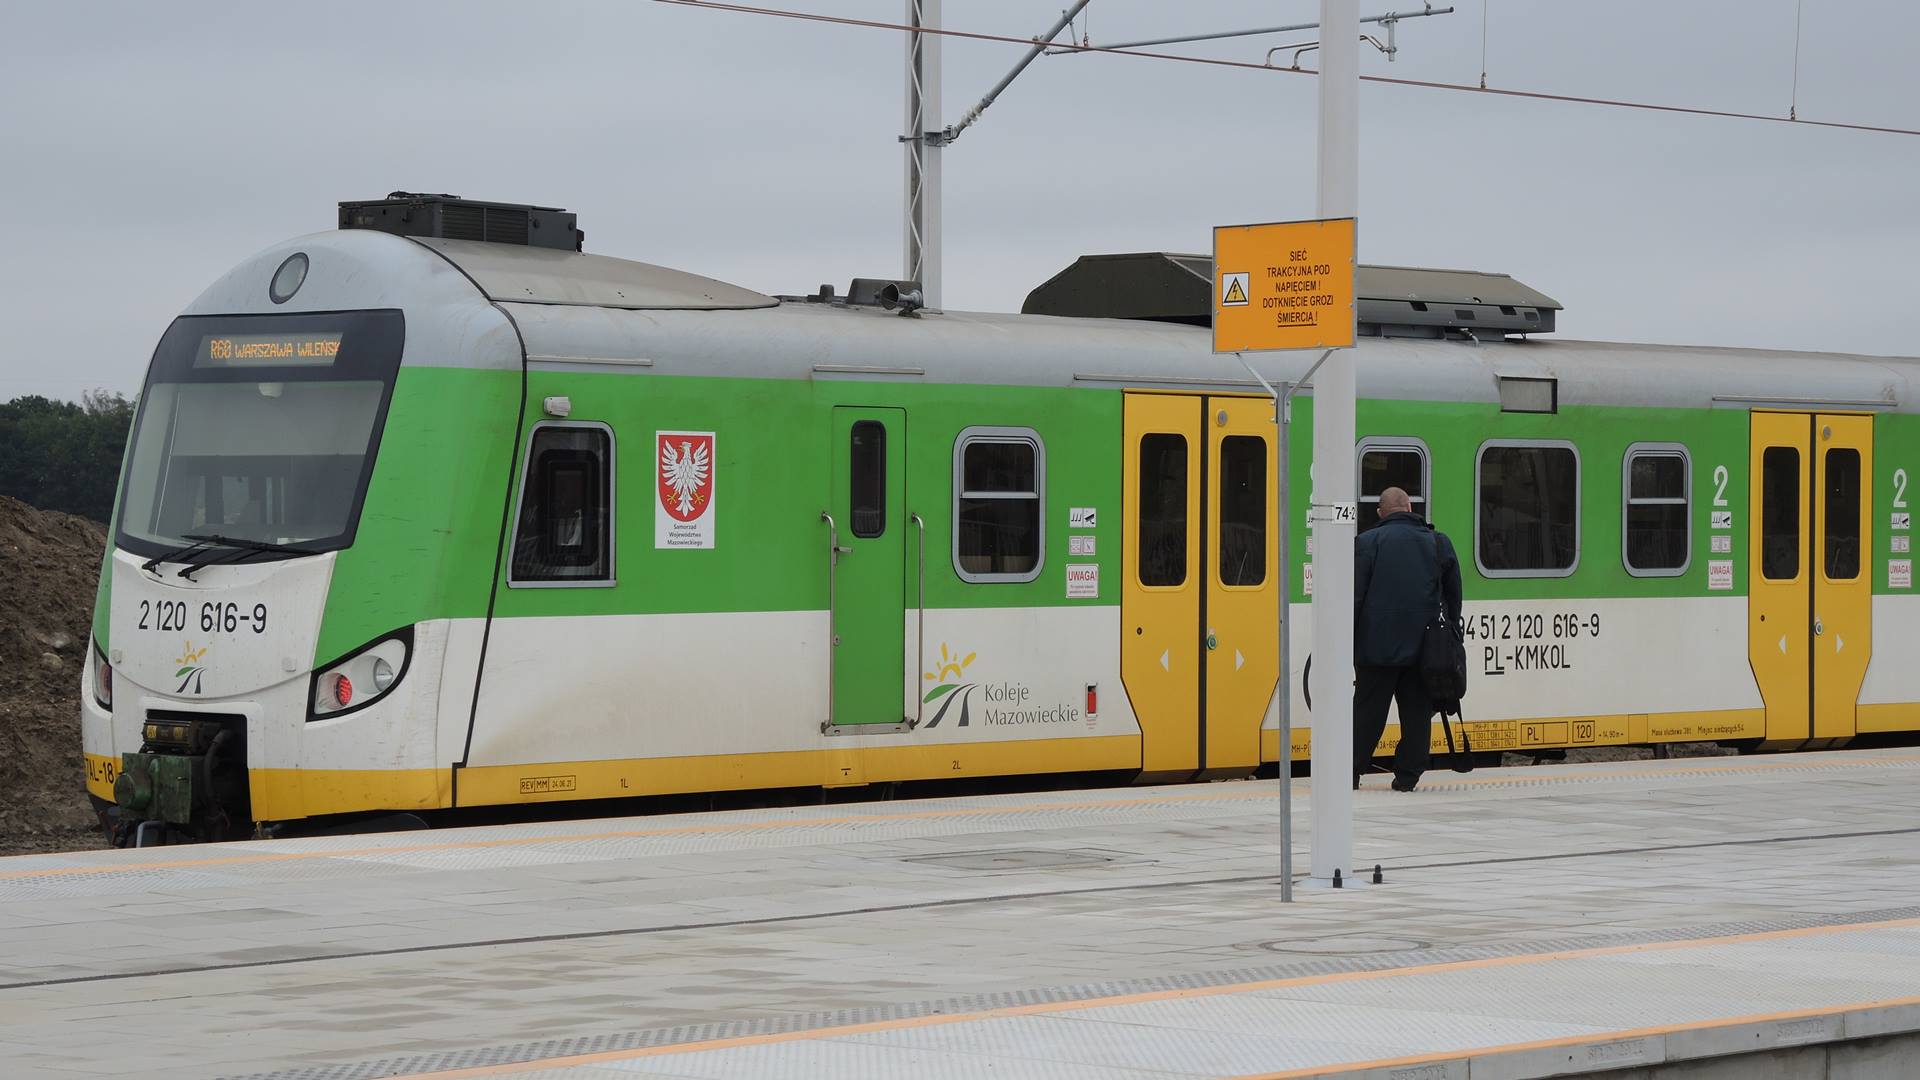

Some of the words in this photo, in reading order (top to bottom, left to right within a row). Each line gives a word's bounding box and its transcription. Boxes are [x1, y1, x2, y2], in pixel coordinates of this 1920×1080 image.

[1290, 248, 1308, 262] SIEĆ
[1267, 266, 1312, 278] TRAKCYJNA
[1314, 264, 1330, 276] POD
[1276, 281, 1316, 294] NAPIĘCIEM
[1262, 296, 1308, 310] DOTKNIĘCIE
[1310, 295, 1334, 306] GROZI
[1278, 310, 1314, 324] ŚMIERCIĄ
[234, 342, 293, 358] WARSZAWA
[1714, 465, 1728, 506] 2
[1893, 468, 1907, 508] 2
[138, 600, 150, 630] 2
[156, 600, 186, 632] 120
[200, 602, 267, 634] 616-9
[1480, 614, 1496, 640] 51
[1501, 614, 1511, 639] 2
[1516, 614, 1543, 638] 120
[1553, 613, 1600, 638] 616-9
[985, 682, 1030, 706] Koleje
[984, 704, 1079, 726] Mazowieckie
[1528, 727, 1539, 740] PL
[1576, 724, 1592, 738] 120
[952, 760, 961, 770] 2L
[522, 782, 534, 790] REV
[536, 780, 548, 789] MM
